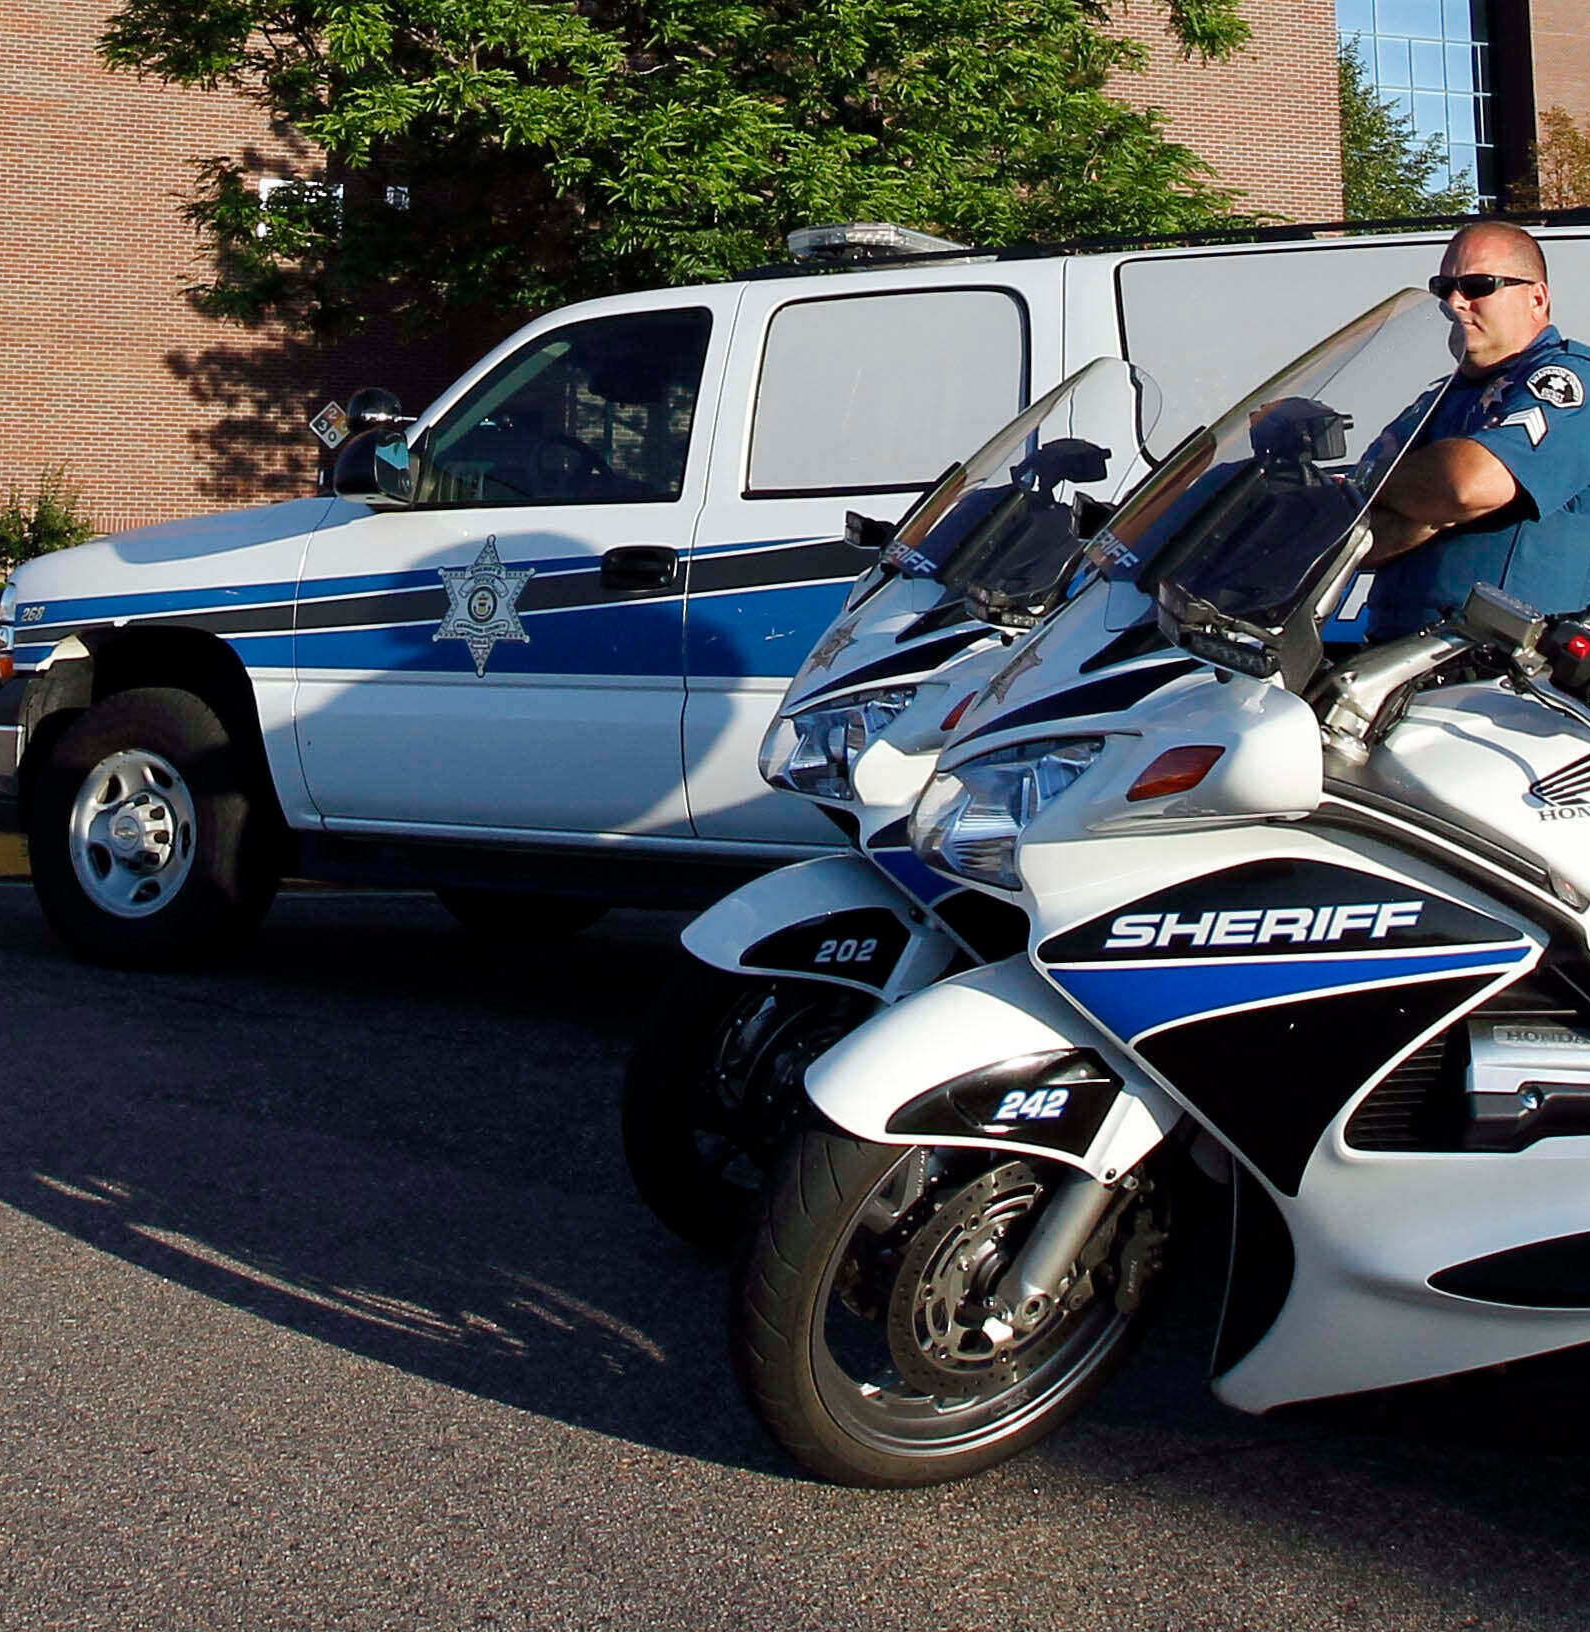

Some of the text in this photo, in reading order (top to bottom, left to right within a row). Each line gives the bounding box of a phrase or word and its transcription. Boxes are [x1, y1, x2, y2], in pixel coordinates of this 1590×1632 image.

[328, 408, 338, 419] 2
[318, 419, 328, 431] 3
[328, 431, 338, 442] 0
[21, 606, 46, 622] 268
[1103, 900, 1425, 949] SHERIFF
[813, 938, 877, 963] 202
[1506, 1030, 1590, 1045] HONDA
[993, 1089, 1069, 1120] 242
